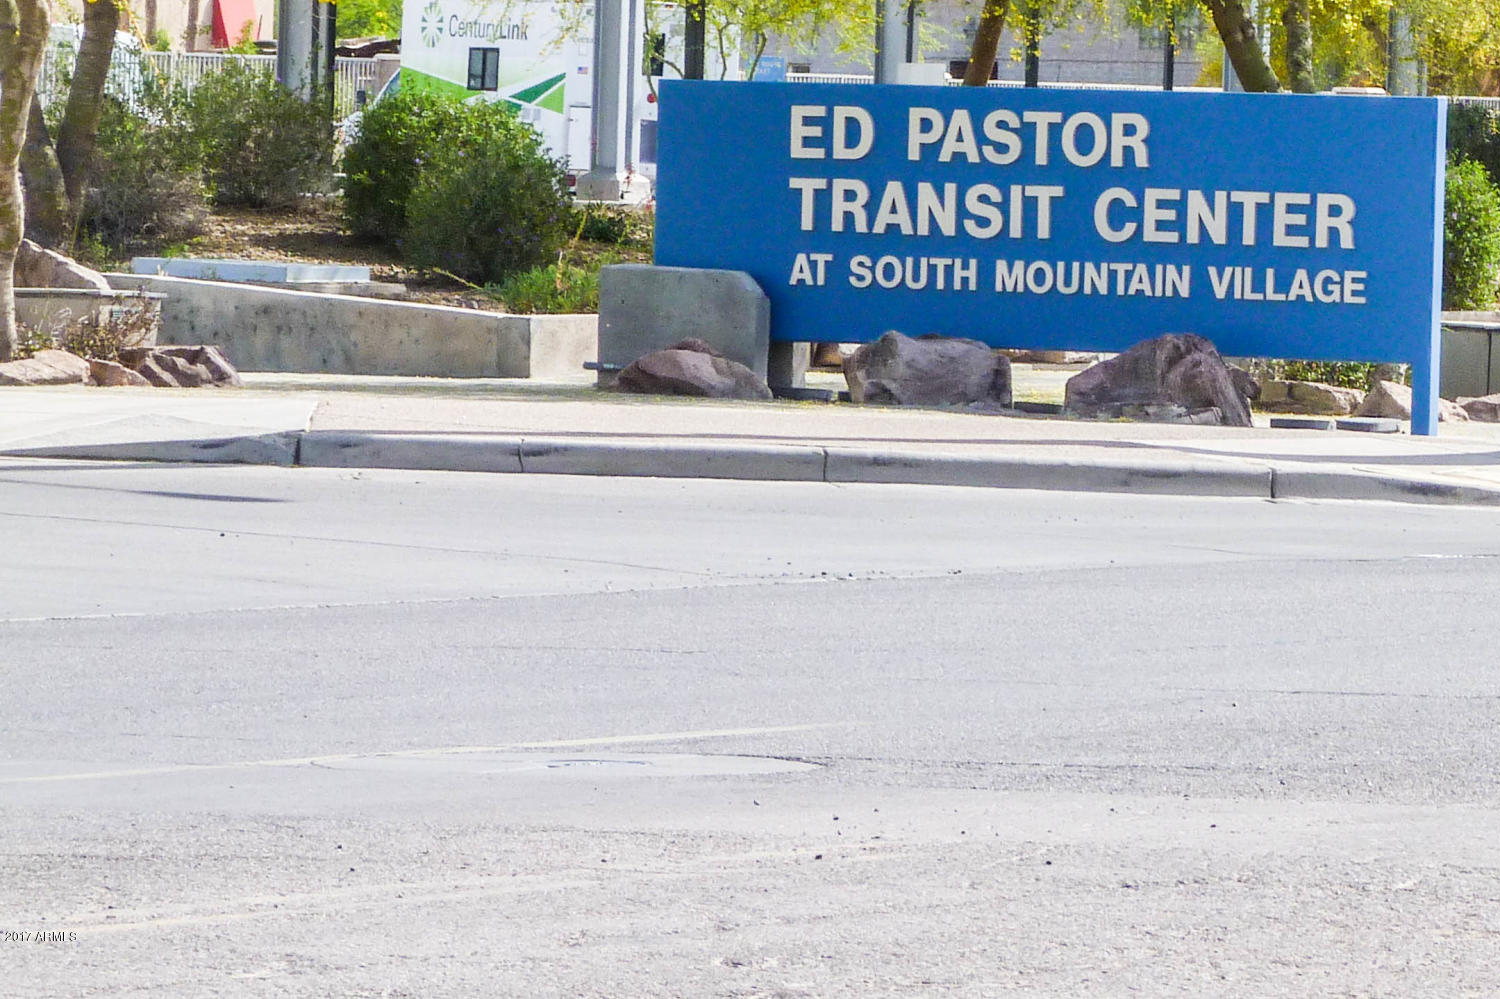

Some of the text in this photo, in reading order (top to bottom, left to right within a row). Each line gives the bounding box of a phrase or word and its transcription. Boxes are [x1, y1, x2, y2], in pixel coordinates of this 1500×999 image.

[449, 14, 529, 41] CenturyLink
[790, 105, 1150, 168] ED PASTOR
[789, 177, 1357, 249] TRANSIT CENTER
[789, 253, 1368, 304] AT SOUTH MOUNTAIN VILLAGE
